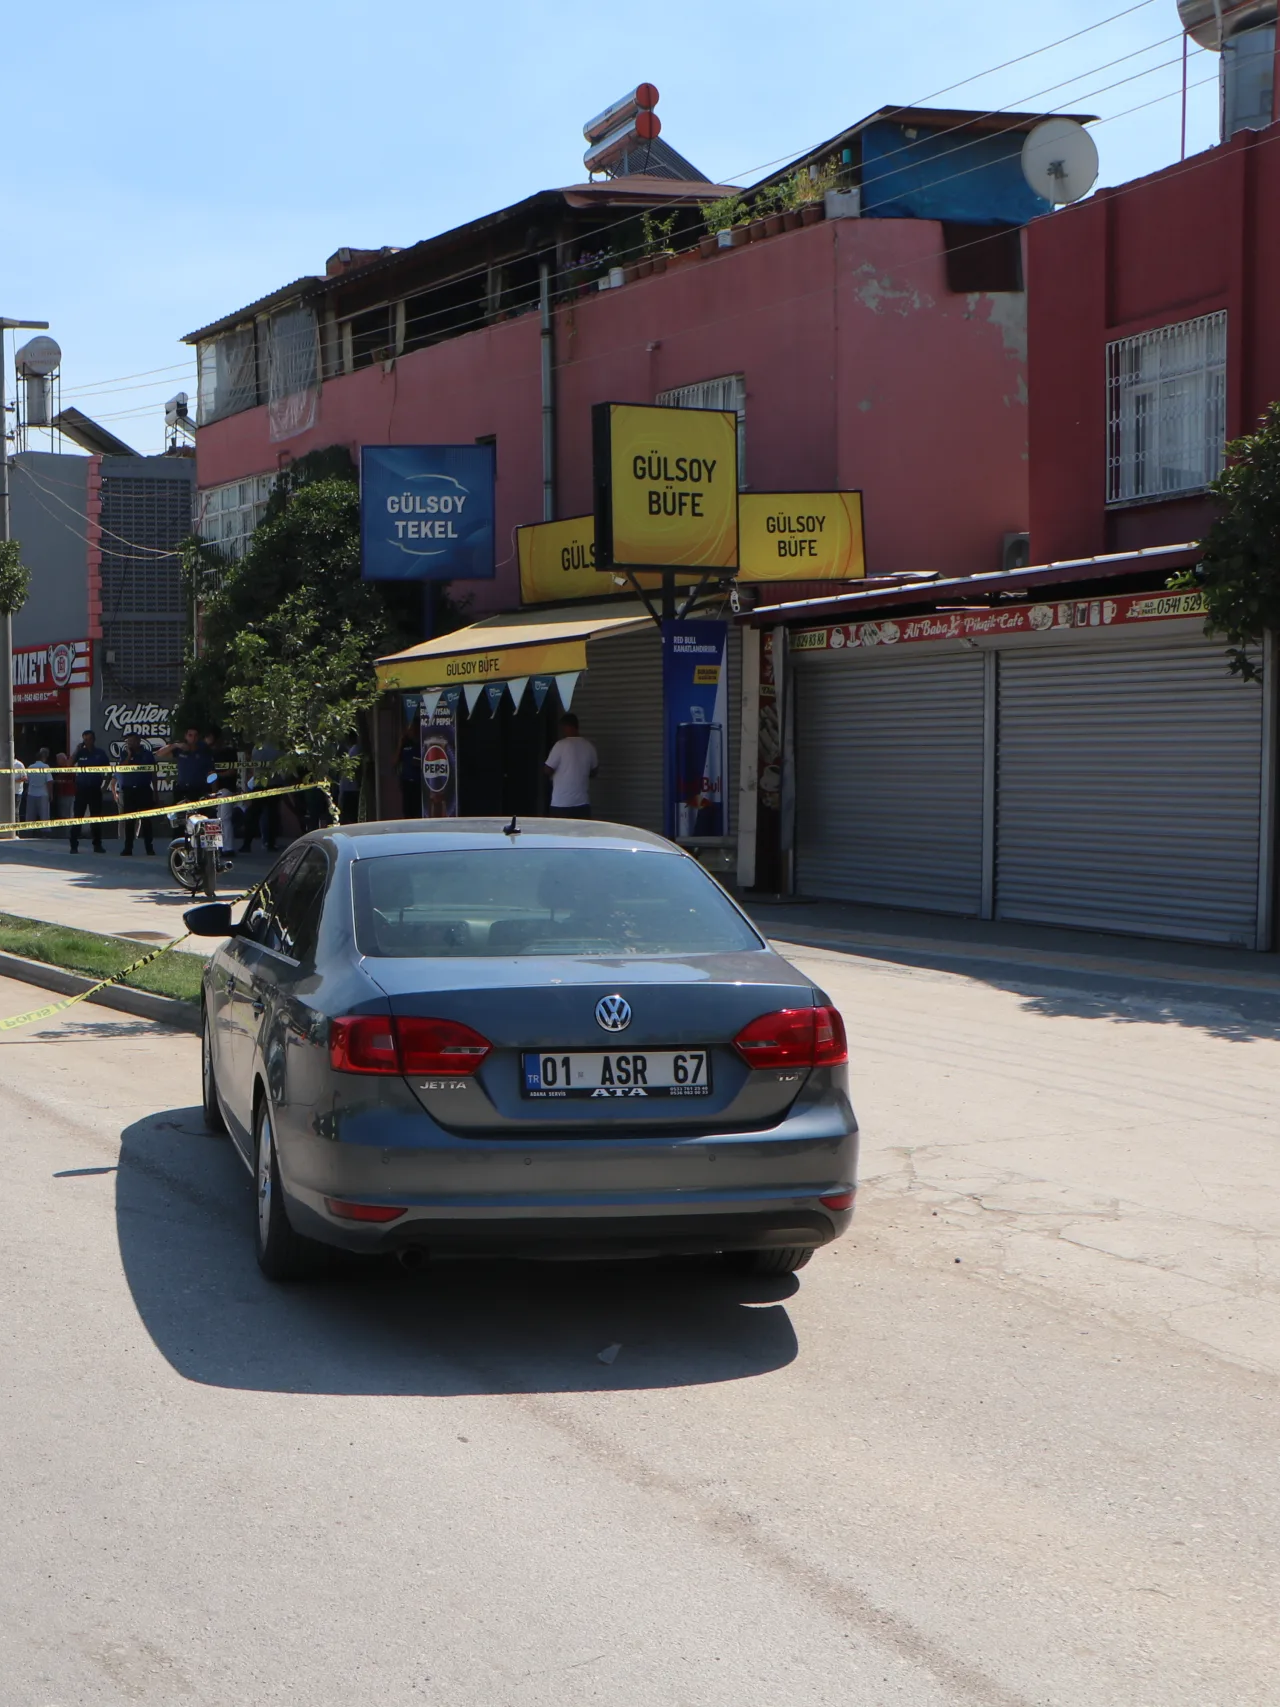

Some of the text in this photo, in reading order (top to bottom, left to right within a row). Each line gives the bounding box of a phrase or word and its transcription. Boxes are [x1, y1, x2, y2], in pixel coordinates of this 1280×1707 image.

[632, 450, 717, 484] GÜLSOY
[386, 492, 466, 513] GÜLSOY
[648, 485, 704, 518] BÜFE
[394, 521, 458, 539] TEKEL
[766, 512, 826, 533] GÜLSOY
[561, 540, 595, 572] GÜLS
[777, 536, 818, 558] BÜFE
[1157, 598, 1180, 615] 0541
[1184, 594, 1202, 612] 529
[903, 612, 1024, 639] Ali Baba Piknik Cafe
[673, 635, 684, 644] RED
[684, 636, 697, 644] BULL
[446, 657, 500, 677] GÜLSOY BÜFE
[105, 702, 171, 731] Kaliten
[424, 763, 448, 774] PEPSI
[528, 1075, 540, 1083] TR
[542, 1054, 704, 1087] 01 ASR 67
[420, 1081, 467, 1090] JETTA
[591, 1088, 648, 1097] ATA
